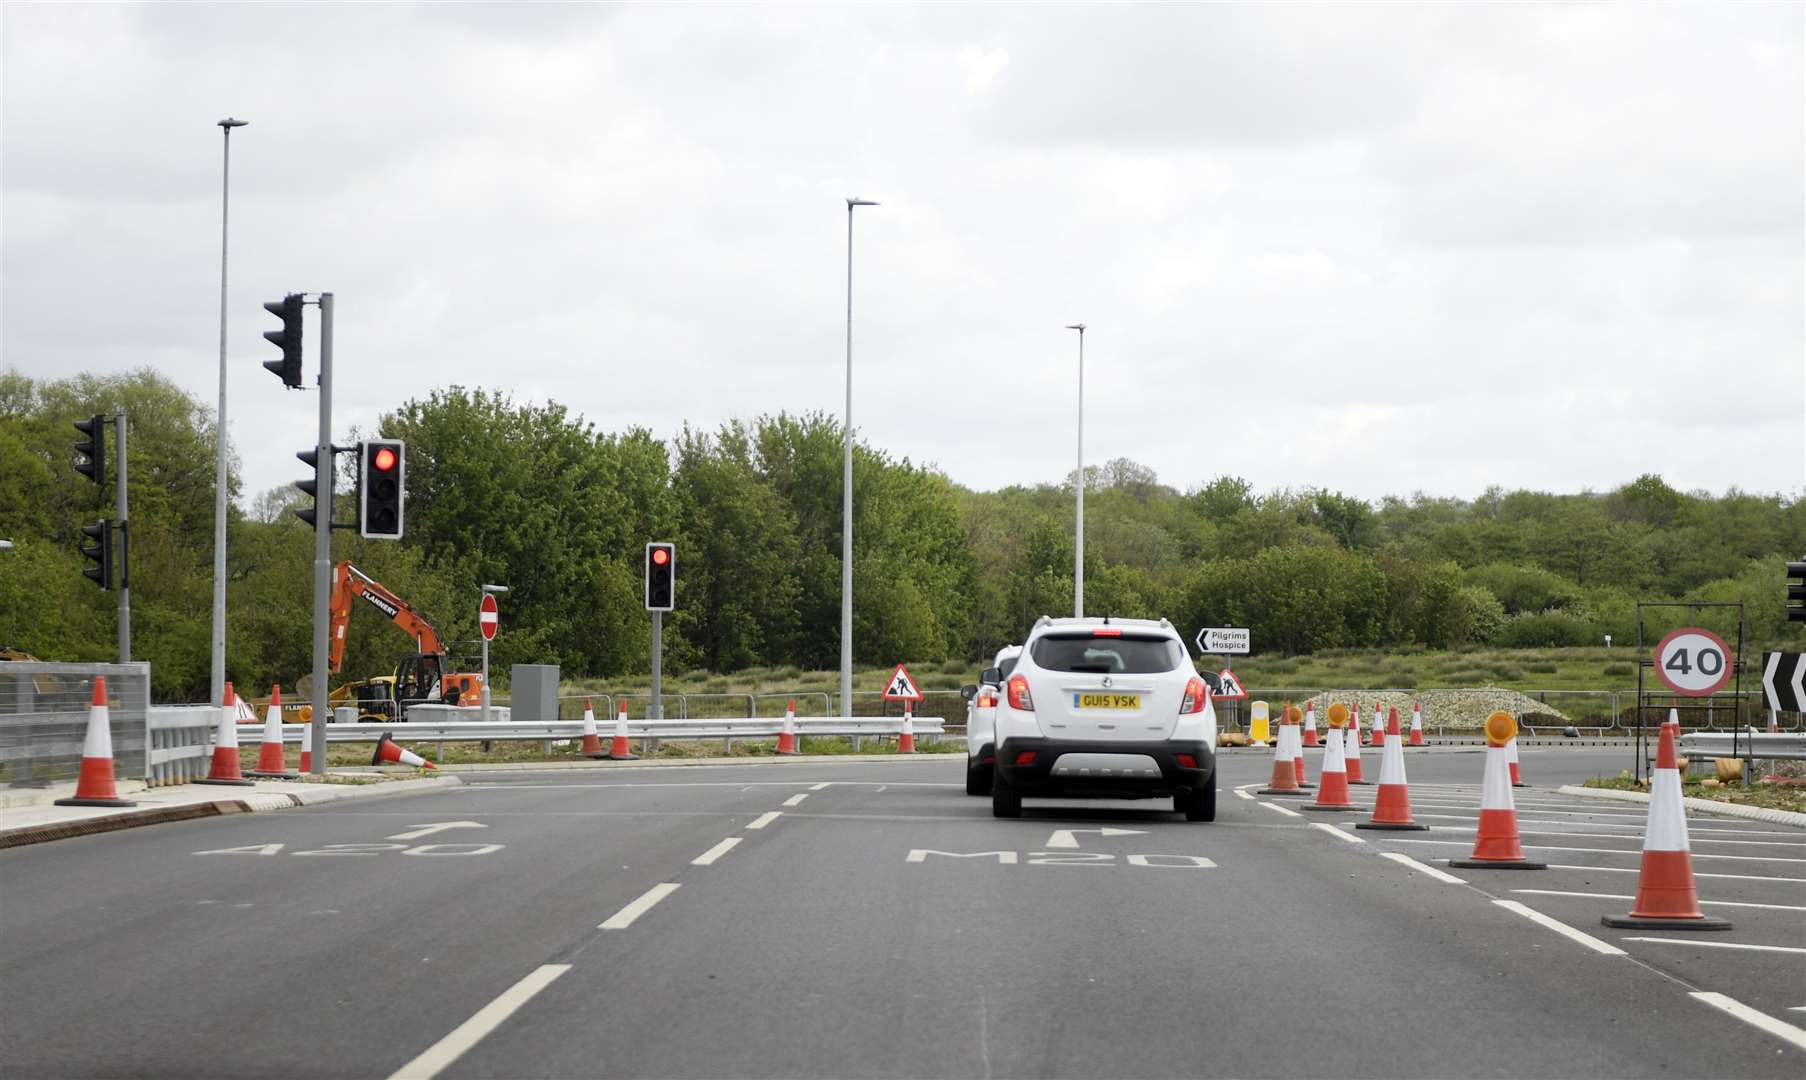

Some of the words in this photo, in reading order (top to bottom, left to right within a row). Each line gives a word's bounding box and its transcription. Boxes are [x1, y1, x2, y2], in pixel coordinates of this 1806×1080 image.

[362, 591, 397, 616] FLANNERY
[1212, 631, 1247, 640] Pilgrims
[1212, 641, 1247, 650] Hospice
[1666, 648, 1722, 675] 40
[1084, 695, 1110, 706] GU15
[1113, 695, 1136, 706] VSK
[191, 843, 506, 856] A20
[905, 849, 1218, 868] M20
